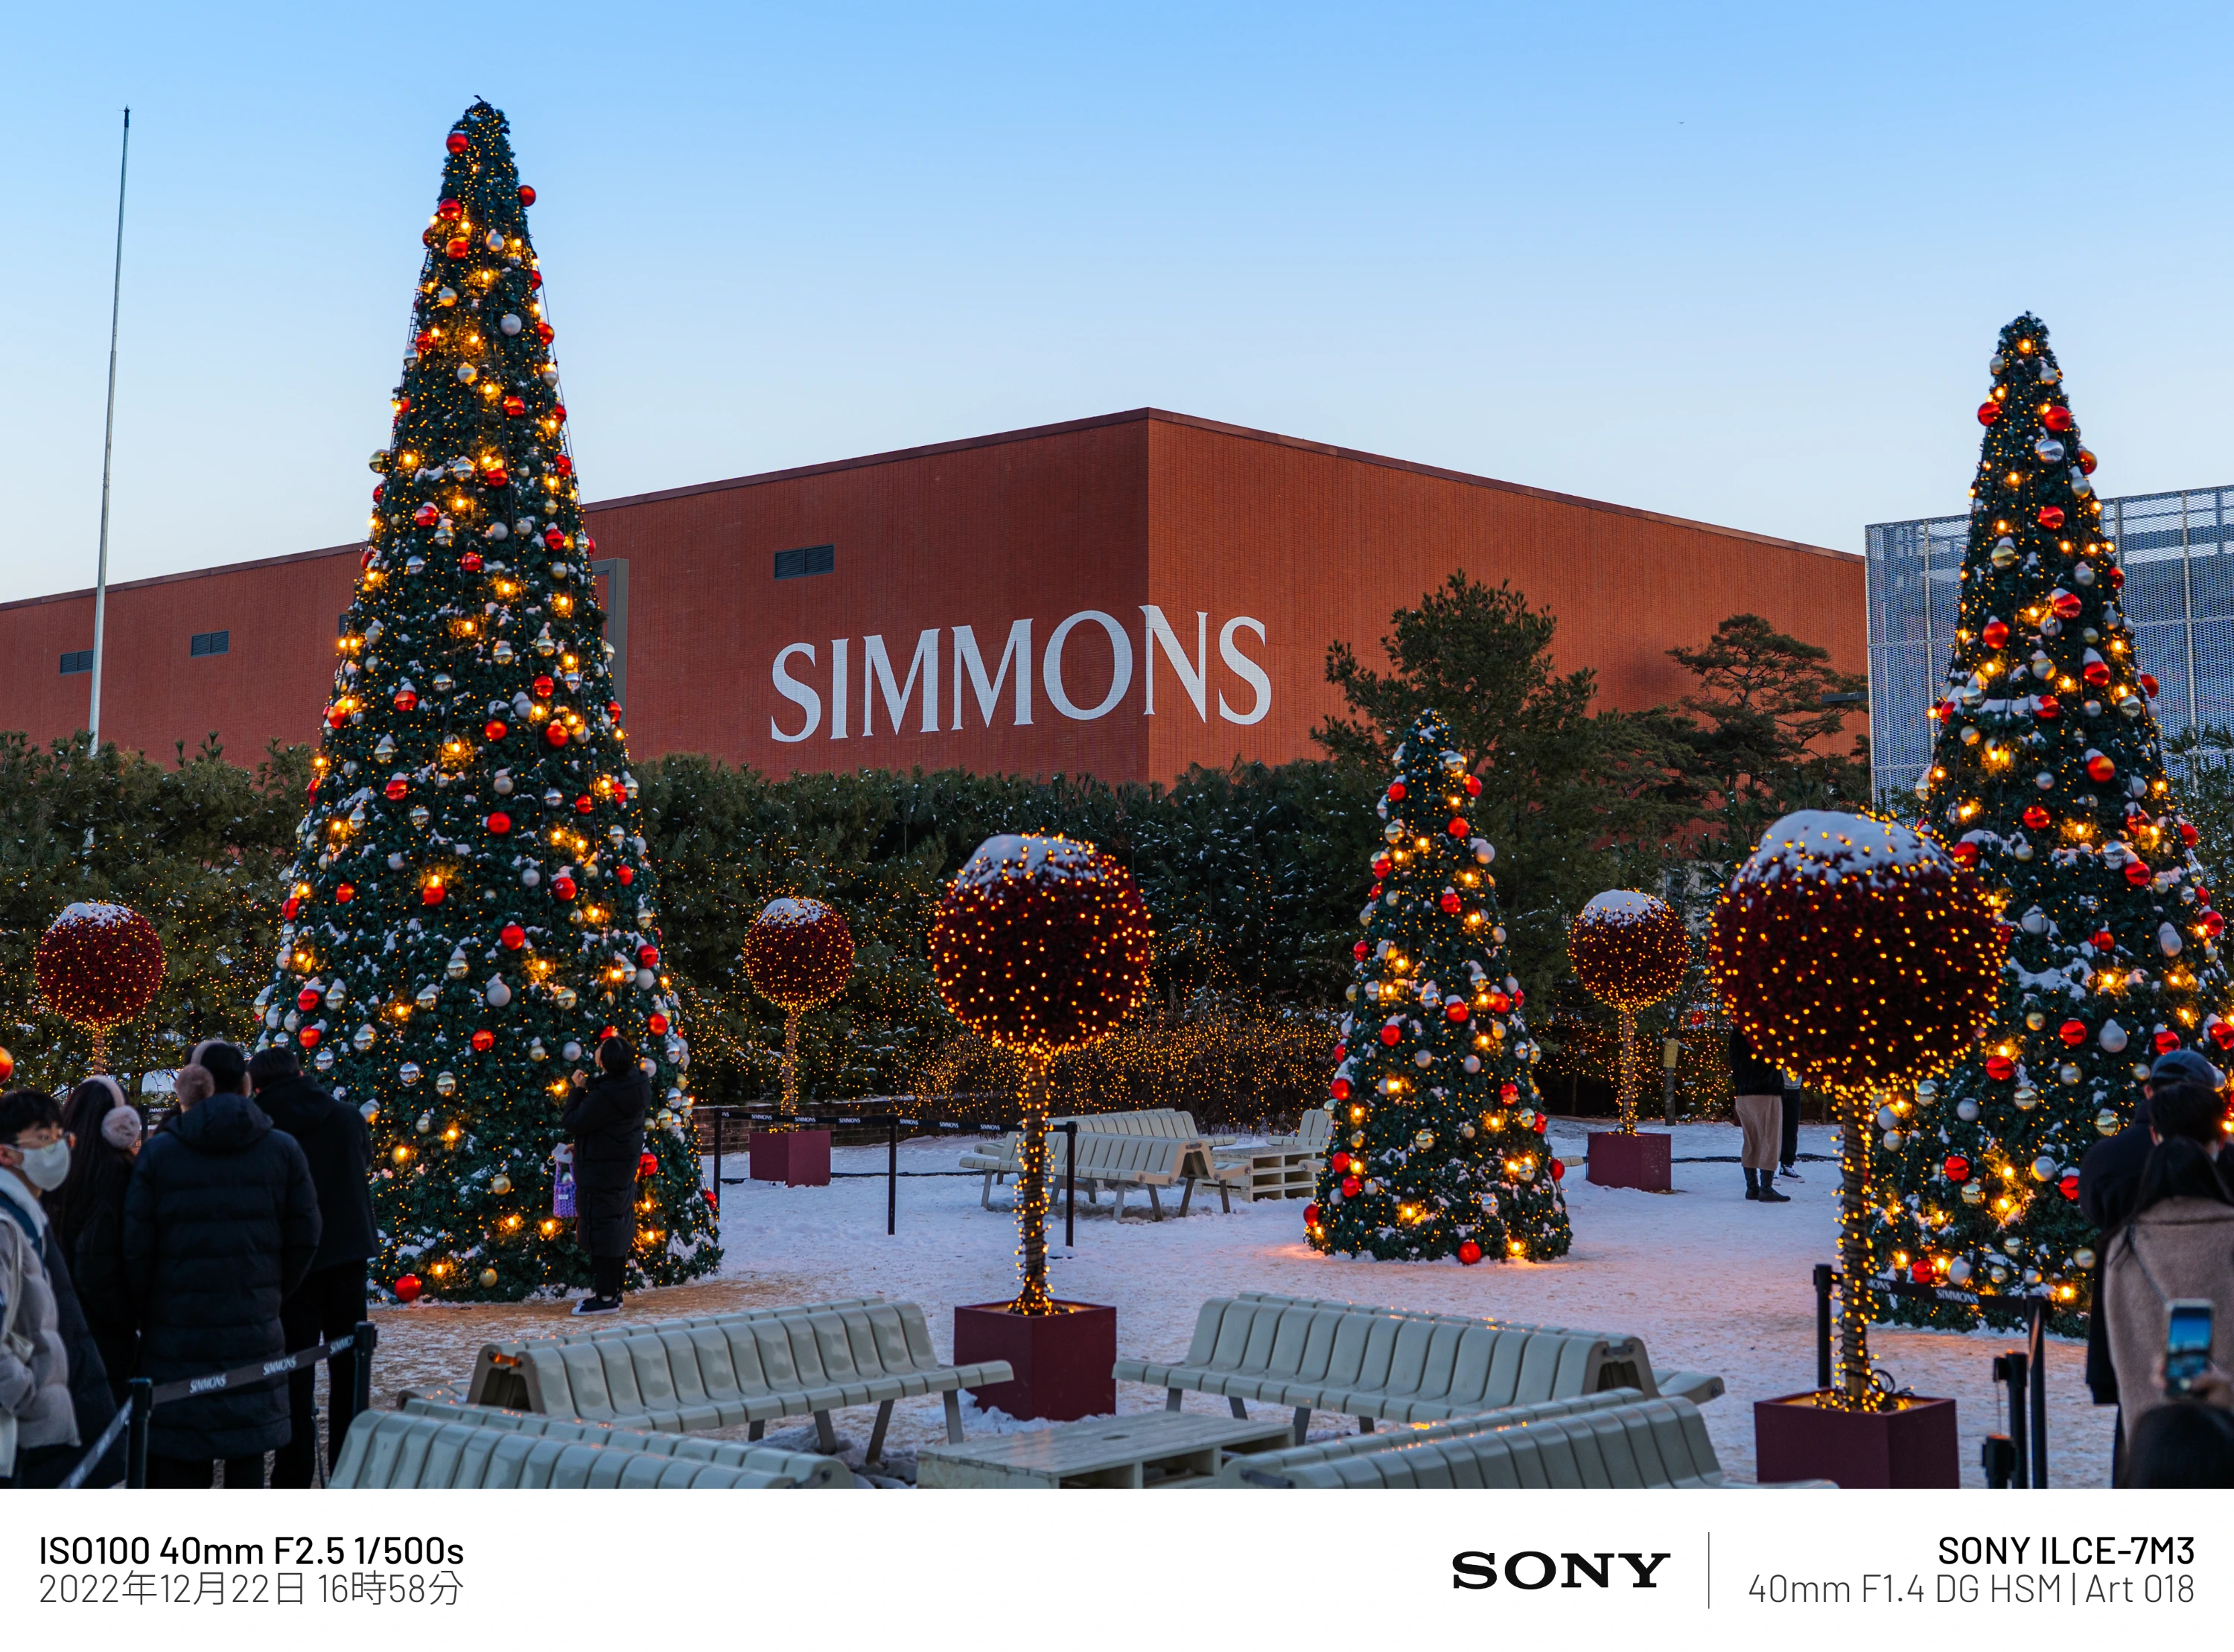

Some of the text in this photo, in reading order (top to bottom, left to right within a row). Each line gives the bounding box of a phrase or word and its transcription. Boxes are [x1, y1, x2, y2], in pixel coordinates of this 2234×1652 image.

[771, 605, 1272, 743] SIMMONS
[1936, 1289, 1979, 1304] SIMMONS
[189, 1373, 227, 1394] SIMMONS
[263, 1355, 297, 1376] SIMMONS
